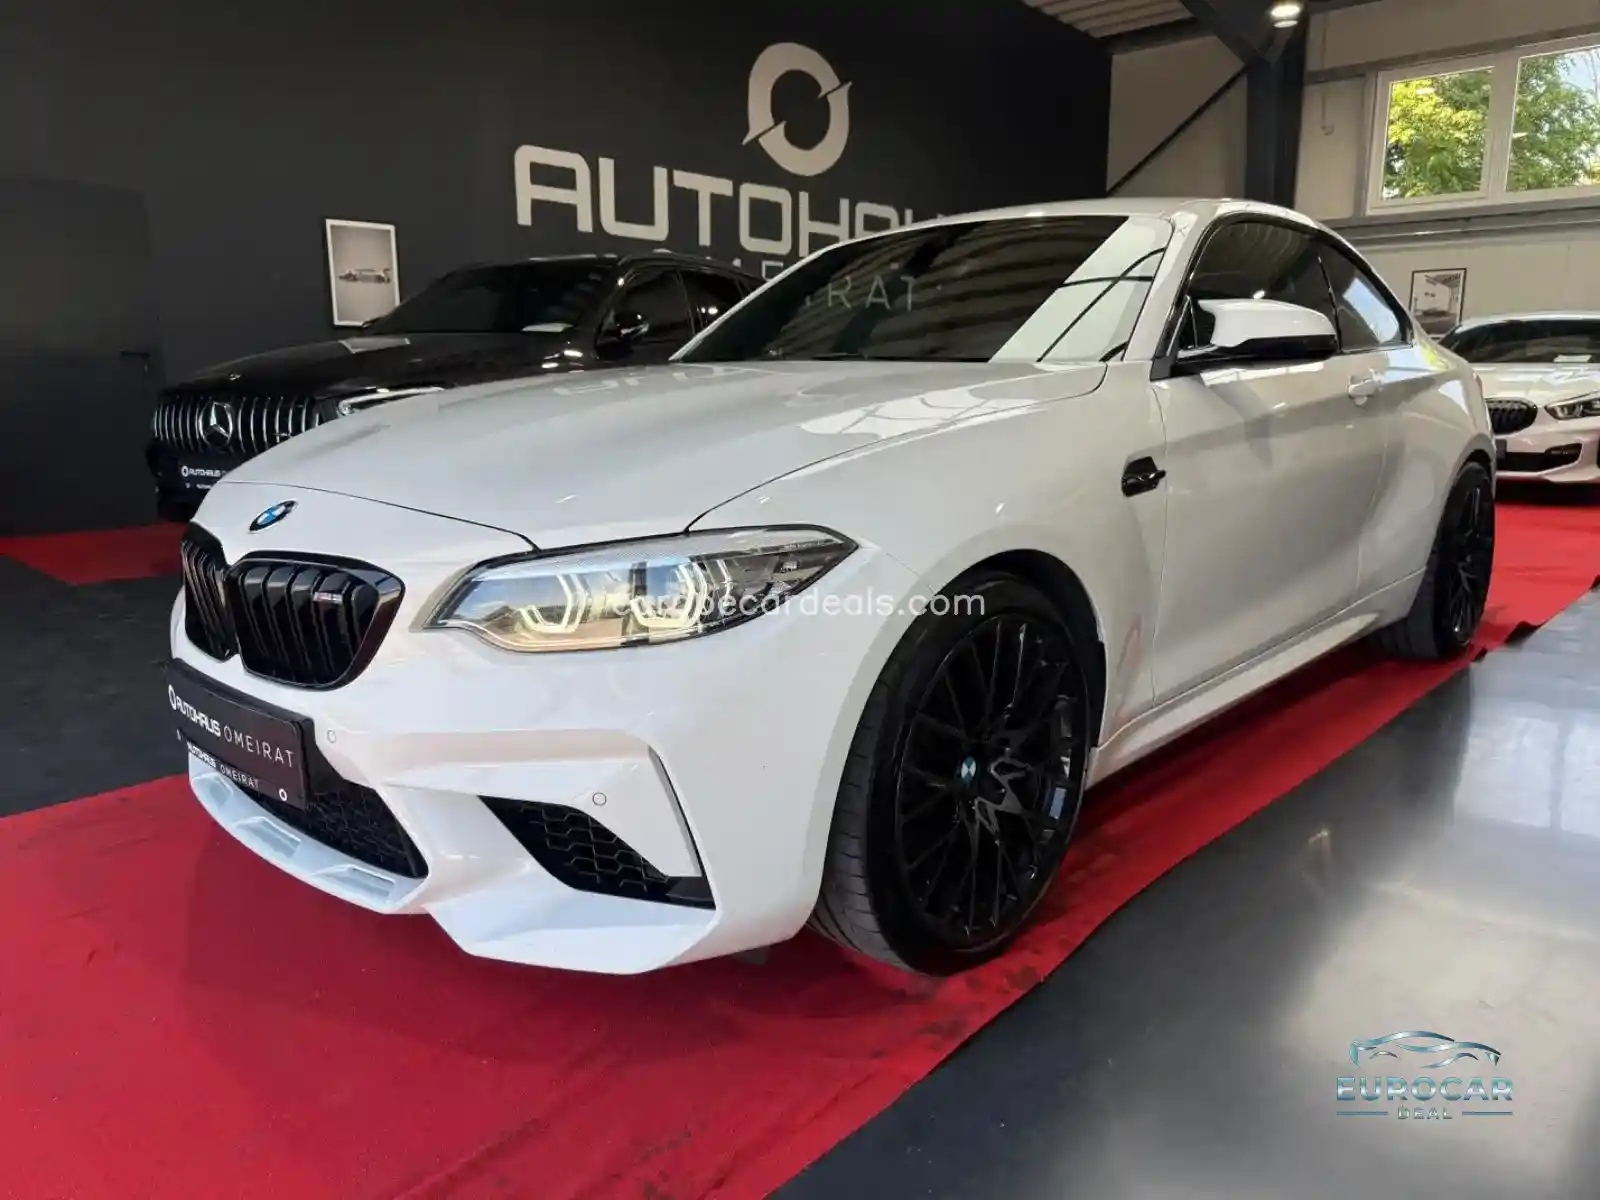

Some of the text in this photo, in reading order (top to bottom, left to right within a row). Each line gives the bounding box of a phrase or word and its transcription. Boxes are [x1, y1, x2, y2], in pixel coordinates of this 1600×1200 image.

[514, 144, 944, 258] AUTOHA
[176, 695, 294, 768] AUTOHAUS OMEIRAT
[220, 764, 259, 789] OMEIRAT
